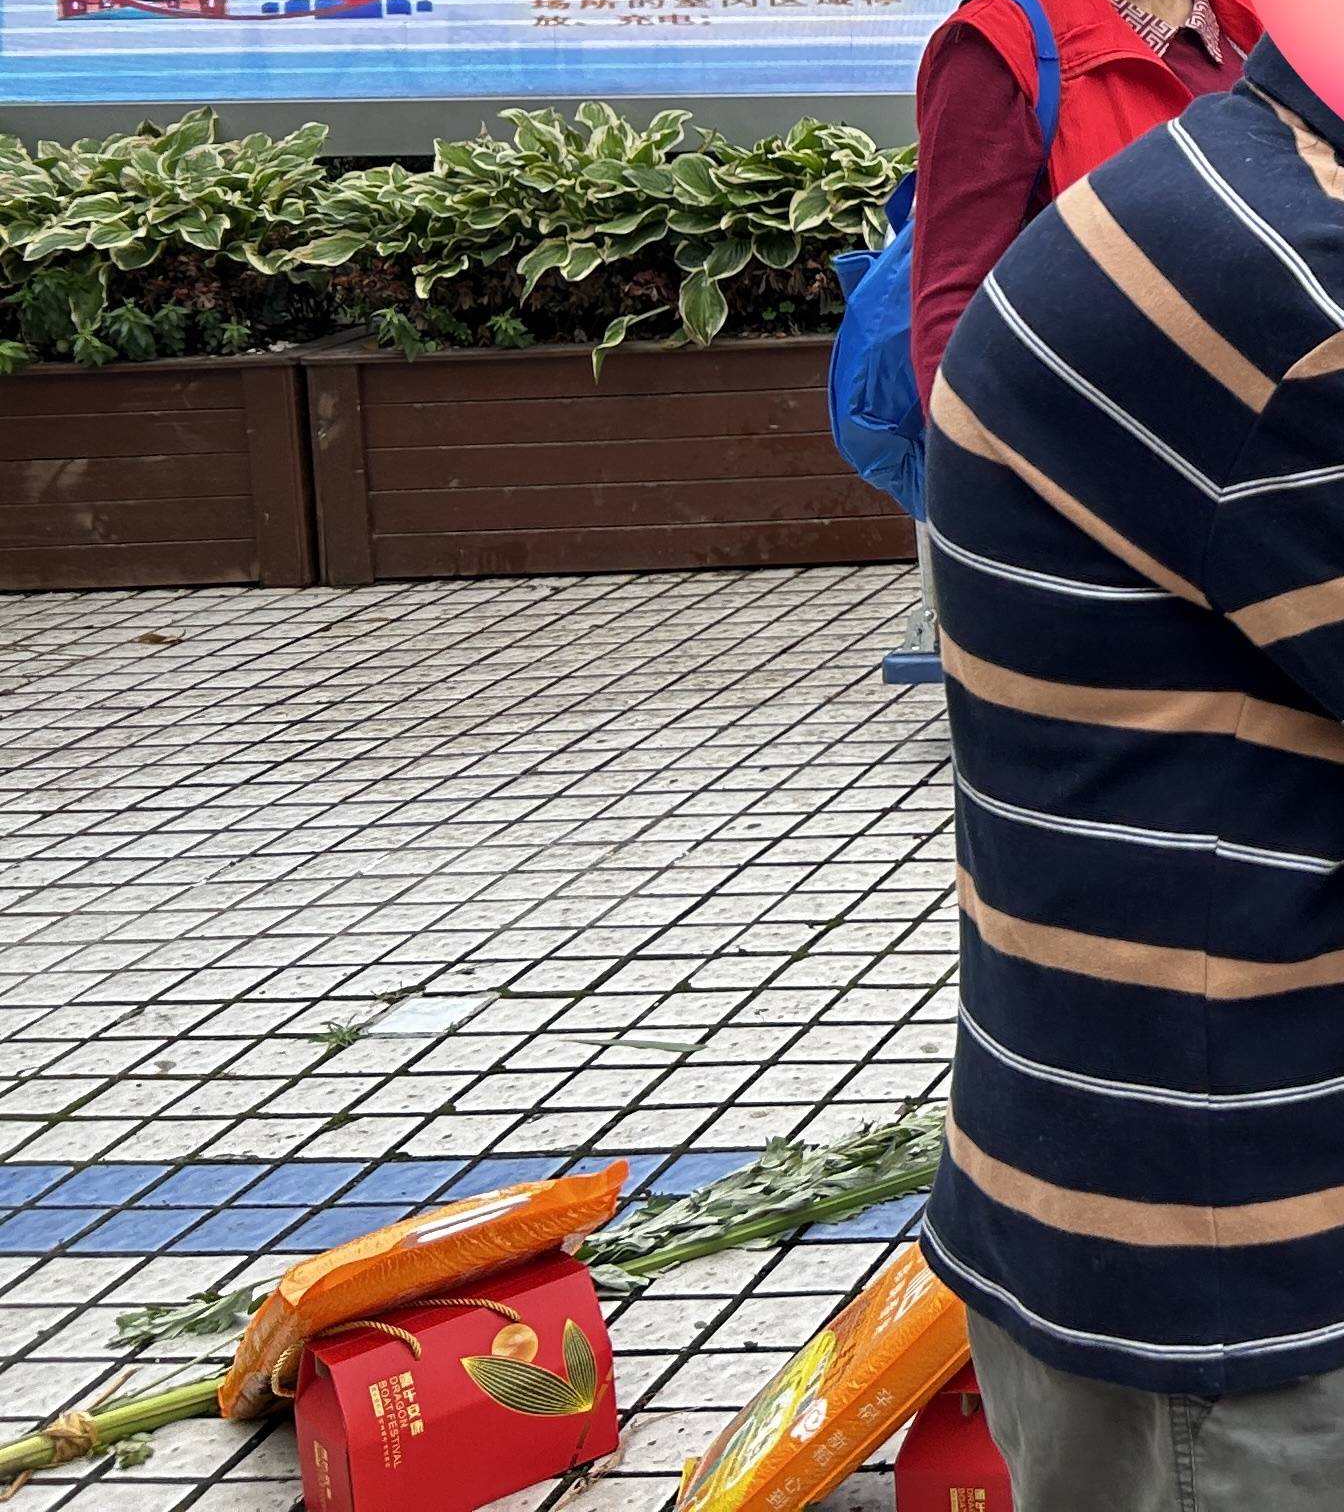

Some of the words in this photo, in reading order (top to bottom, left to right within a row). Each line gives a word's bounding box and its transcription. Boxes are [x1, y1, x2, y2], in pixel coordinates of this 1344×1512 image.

[378, 1379, 395, 1412] BOAT
[389, 1376, 409, 1429] DRAGON
[386, 1413, 403, 1469] FESTIVAL
